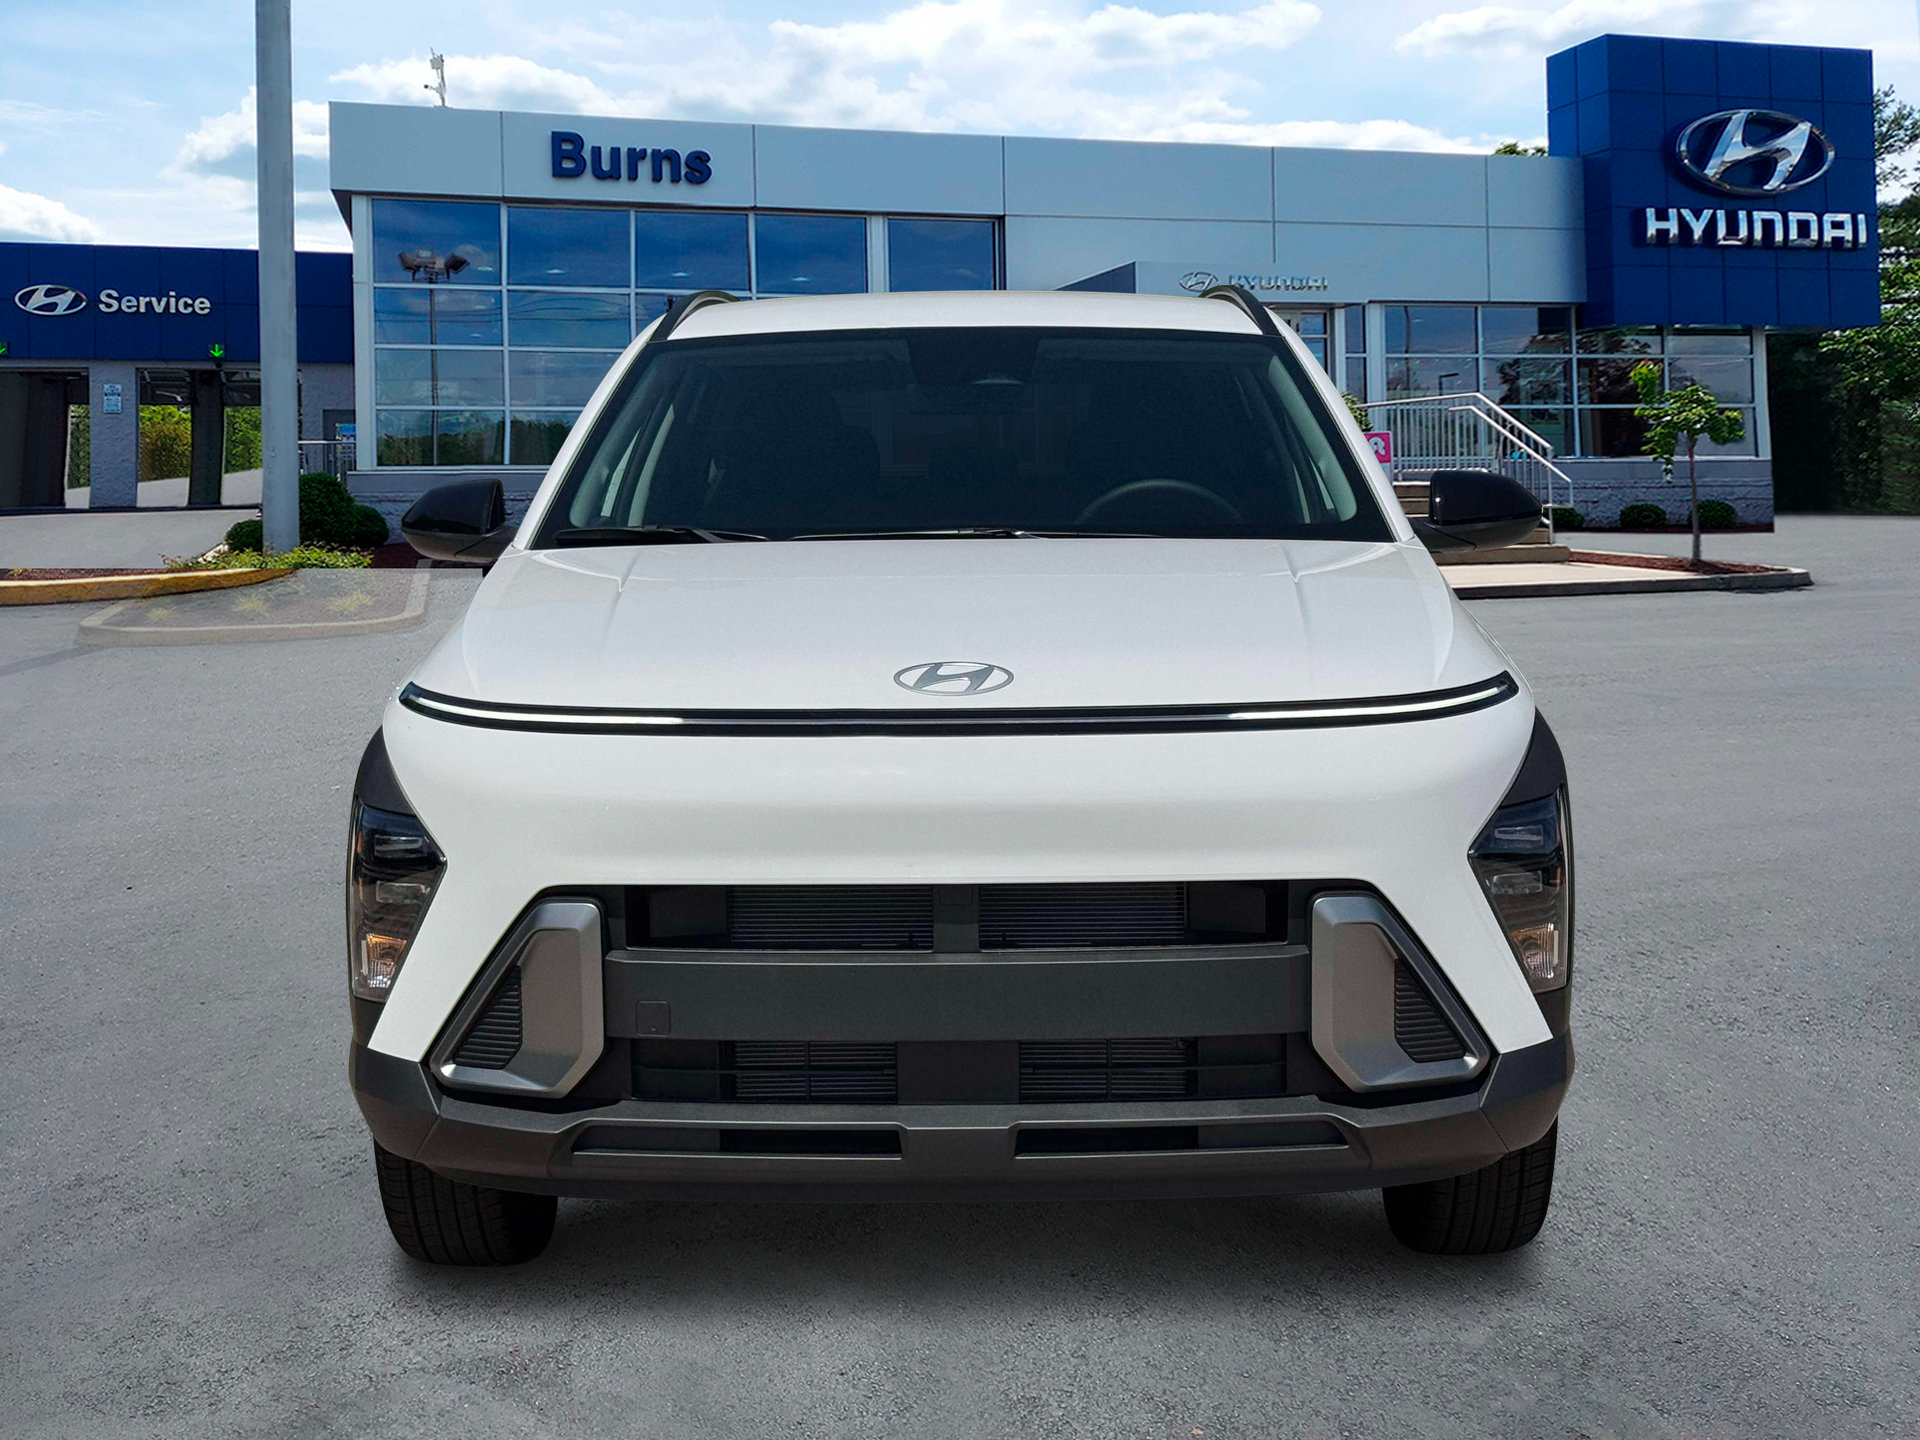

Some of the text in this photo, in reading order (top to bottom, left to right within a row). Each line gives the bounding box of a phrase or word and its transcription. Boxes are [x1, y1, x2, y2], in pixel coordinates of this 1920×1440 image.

[550, 131, 712, 185] Burns
[1645, 207, 1868, 249] HYUNDAI
[98, 289, 212, 315] Service
